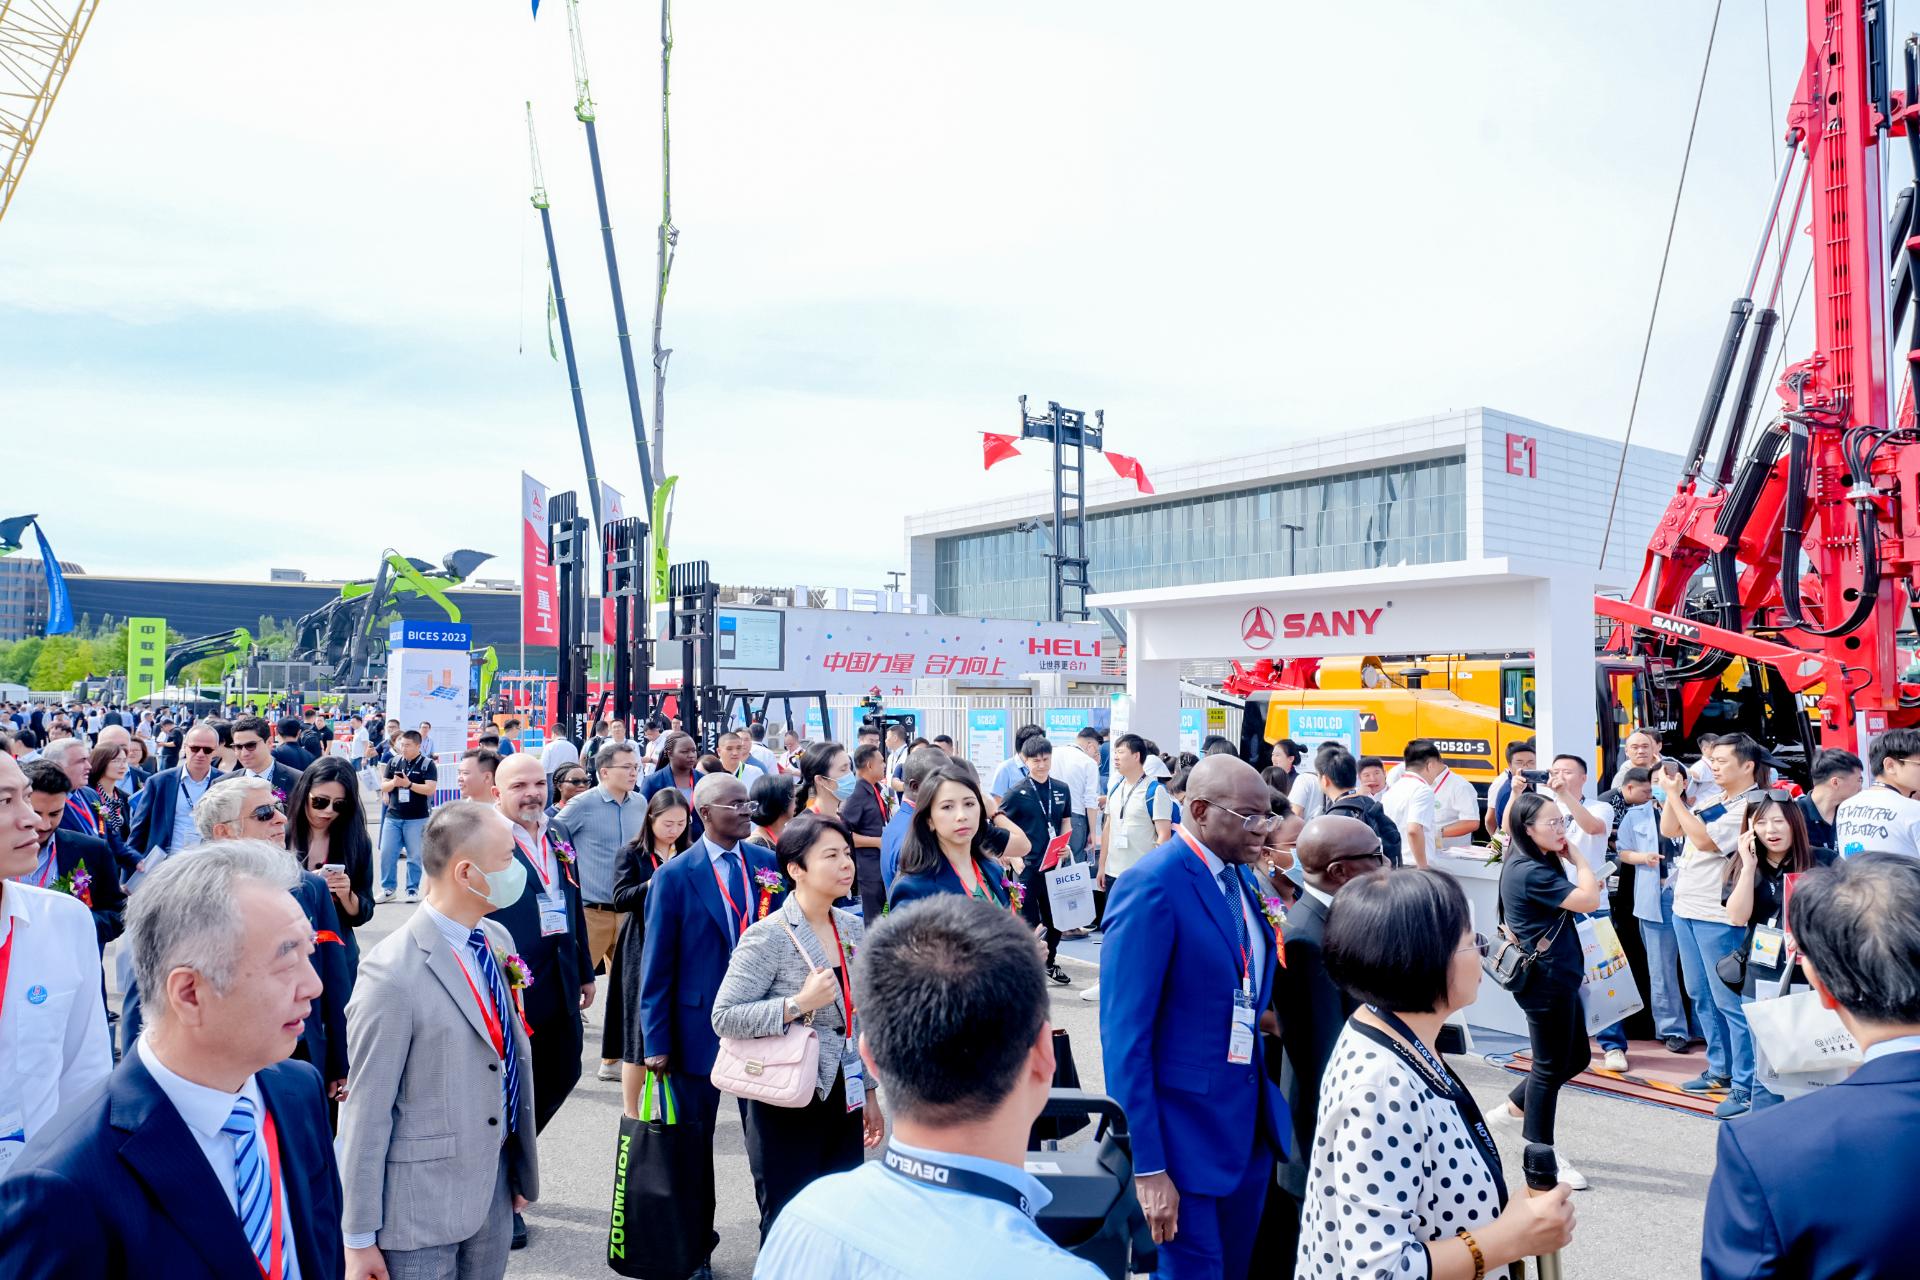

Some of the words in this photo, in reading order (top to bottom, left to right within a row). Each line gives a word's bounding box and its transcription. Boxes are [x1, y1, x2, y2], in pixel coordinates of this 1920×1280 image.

[1506, 433, 1536, 478] E1
[536, 546, 553, 633] 三一重工
[1283, 608, 1383, 638] SANY
[1651, 616, 1695, 636] SANY
[408, 631, 439, 641] BICES
[441, 632, 466, 642] 2023
[1028, 637, 1100, 657] HELI
[823, 651, 915, 674] 中国力量
[925, 654, 1006, 676] 合力向上
[1039, 660, 1087, 671] 让世界更合力
[575, 713, 583, 740] SANY
[637, 718, 646, 747] SANY
[1299, 716, 1343, 730] SA10LCD
[708, 721, 716, 753] SANY
[1433, 741, 1485, 753] SD520-S
[1055, 872, 1081, 885] BICES
[1413, 1039, 1432, 1063] 2023
[1431, 1059, 1452, 1086] BICES
[610, 1135, 631, 1260] ZOOMLION
